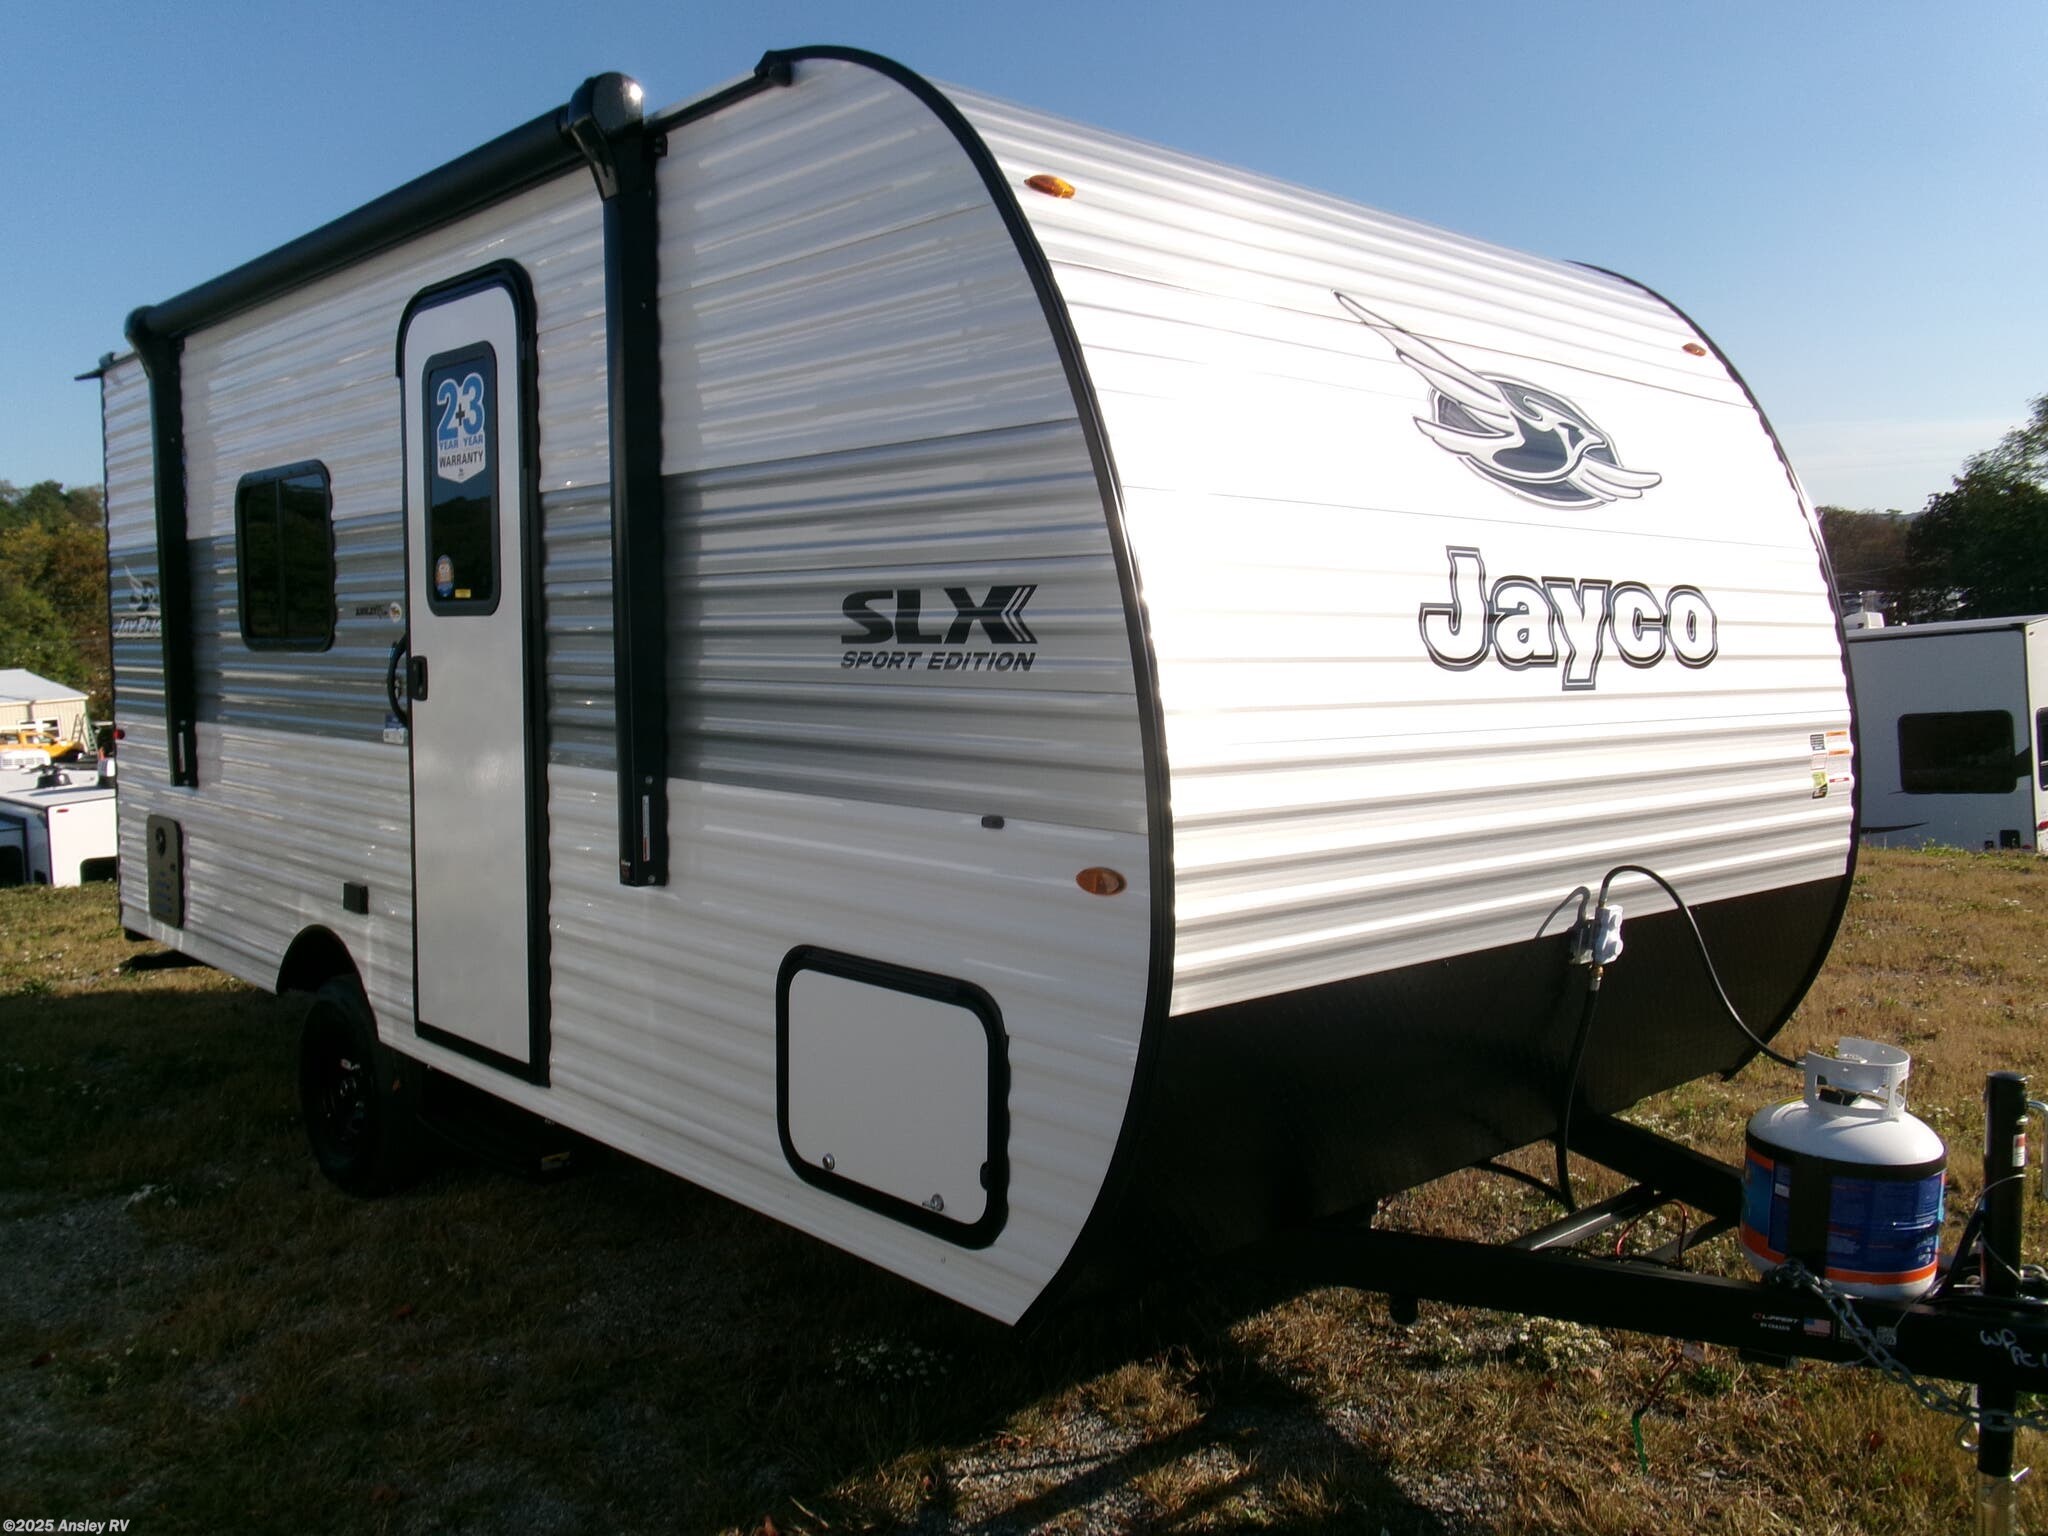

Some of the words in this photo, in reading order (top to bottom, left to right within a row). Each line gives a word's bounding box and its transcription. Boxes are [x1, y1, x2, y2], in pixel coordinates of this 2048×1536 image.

[439, 439, 459, 451] YEAR
[463, 434, 483, 447] YEAR
[439, 450, 484, 468] WARRANTY
[841, 584, 1038, 644] SLX
[1418, 545, 1718, 691] Jayco
[840, 651, 923, 670] SPORT
[927, 652, 1036, 672] EDITION
